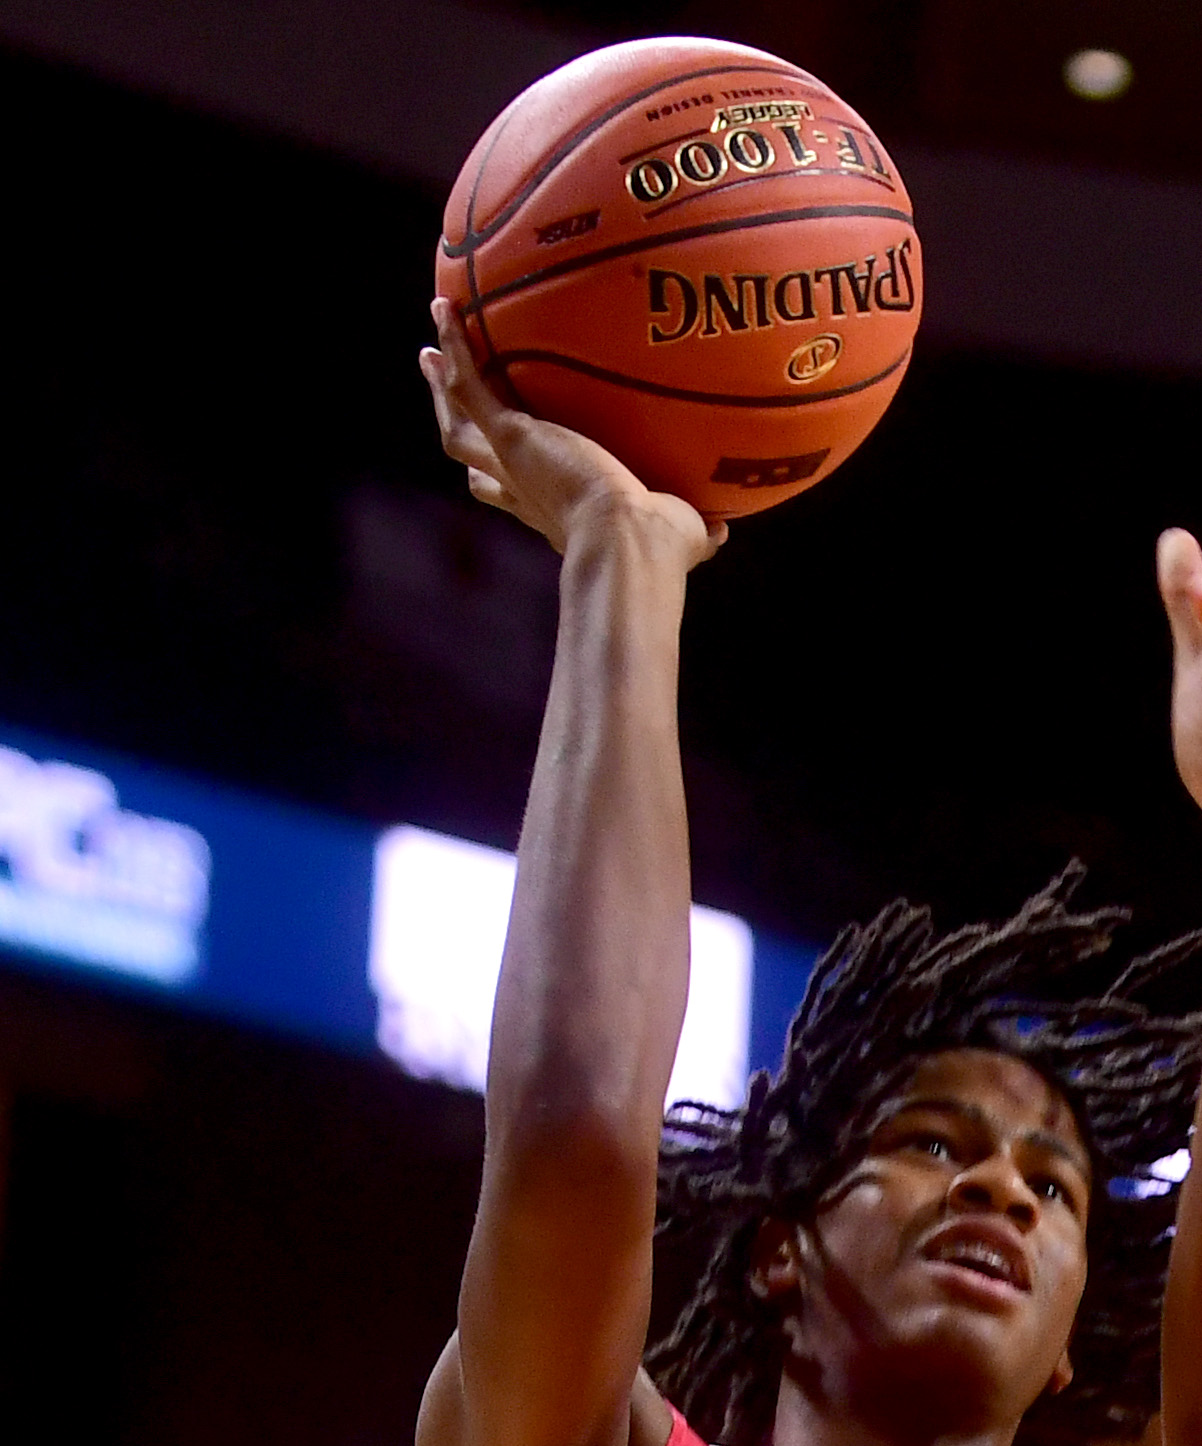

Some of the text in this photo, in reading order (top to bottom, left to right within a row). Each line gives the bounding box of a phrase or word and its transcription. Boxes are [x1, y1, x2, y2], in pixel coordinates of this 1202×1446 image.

[709, 100, 815, 134] LEGACY
[624, 120, 893, 204] TF-1000
[648, 238, 915, 345] SPALDING
